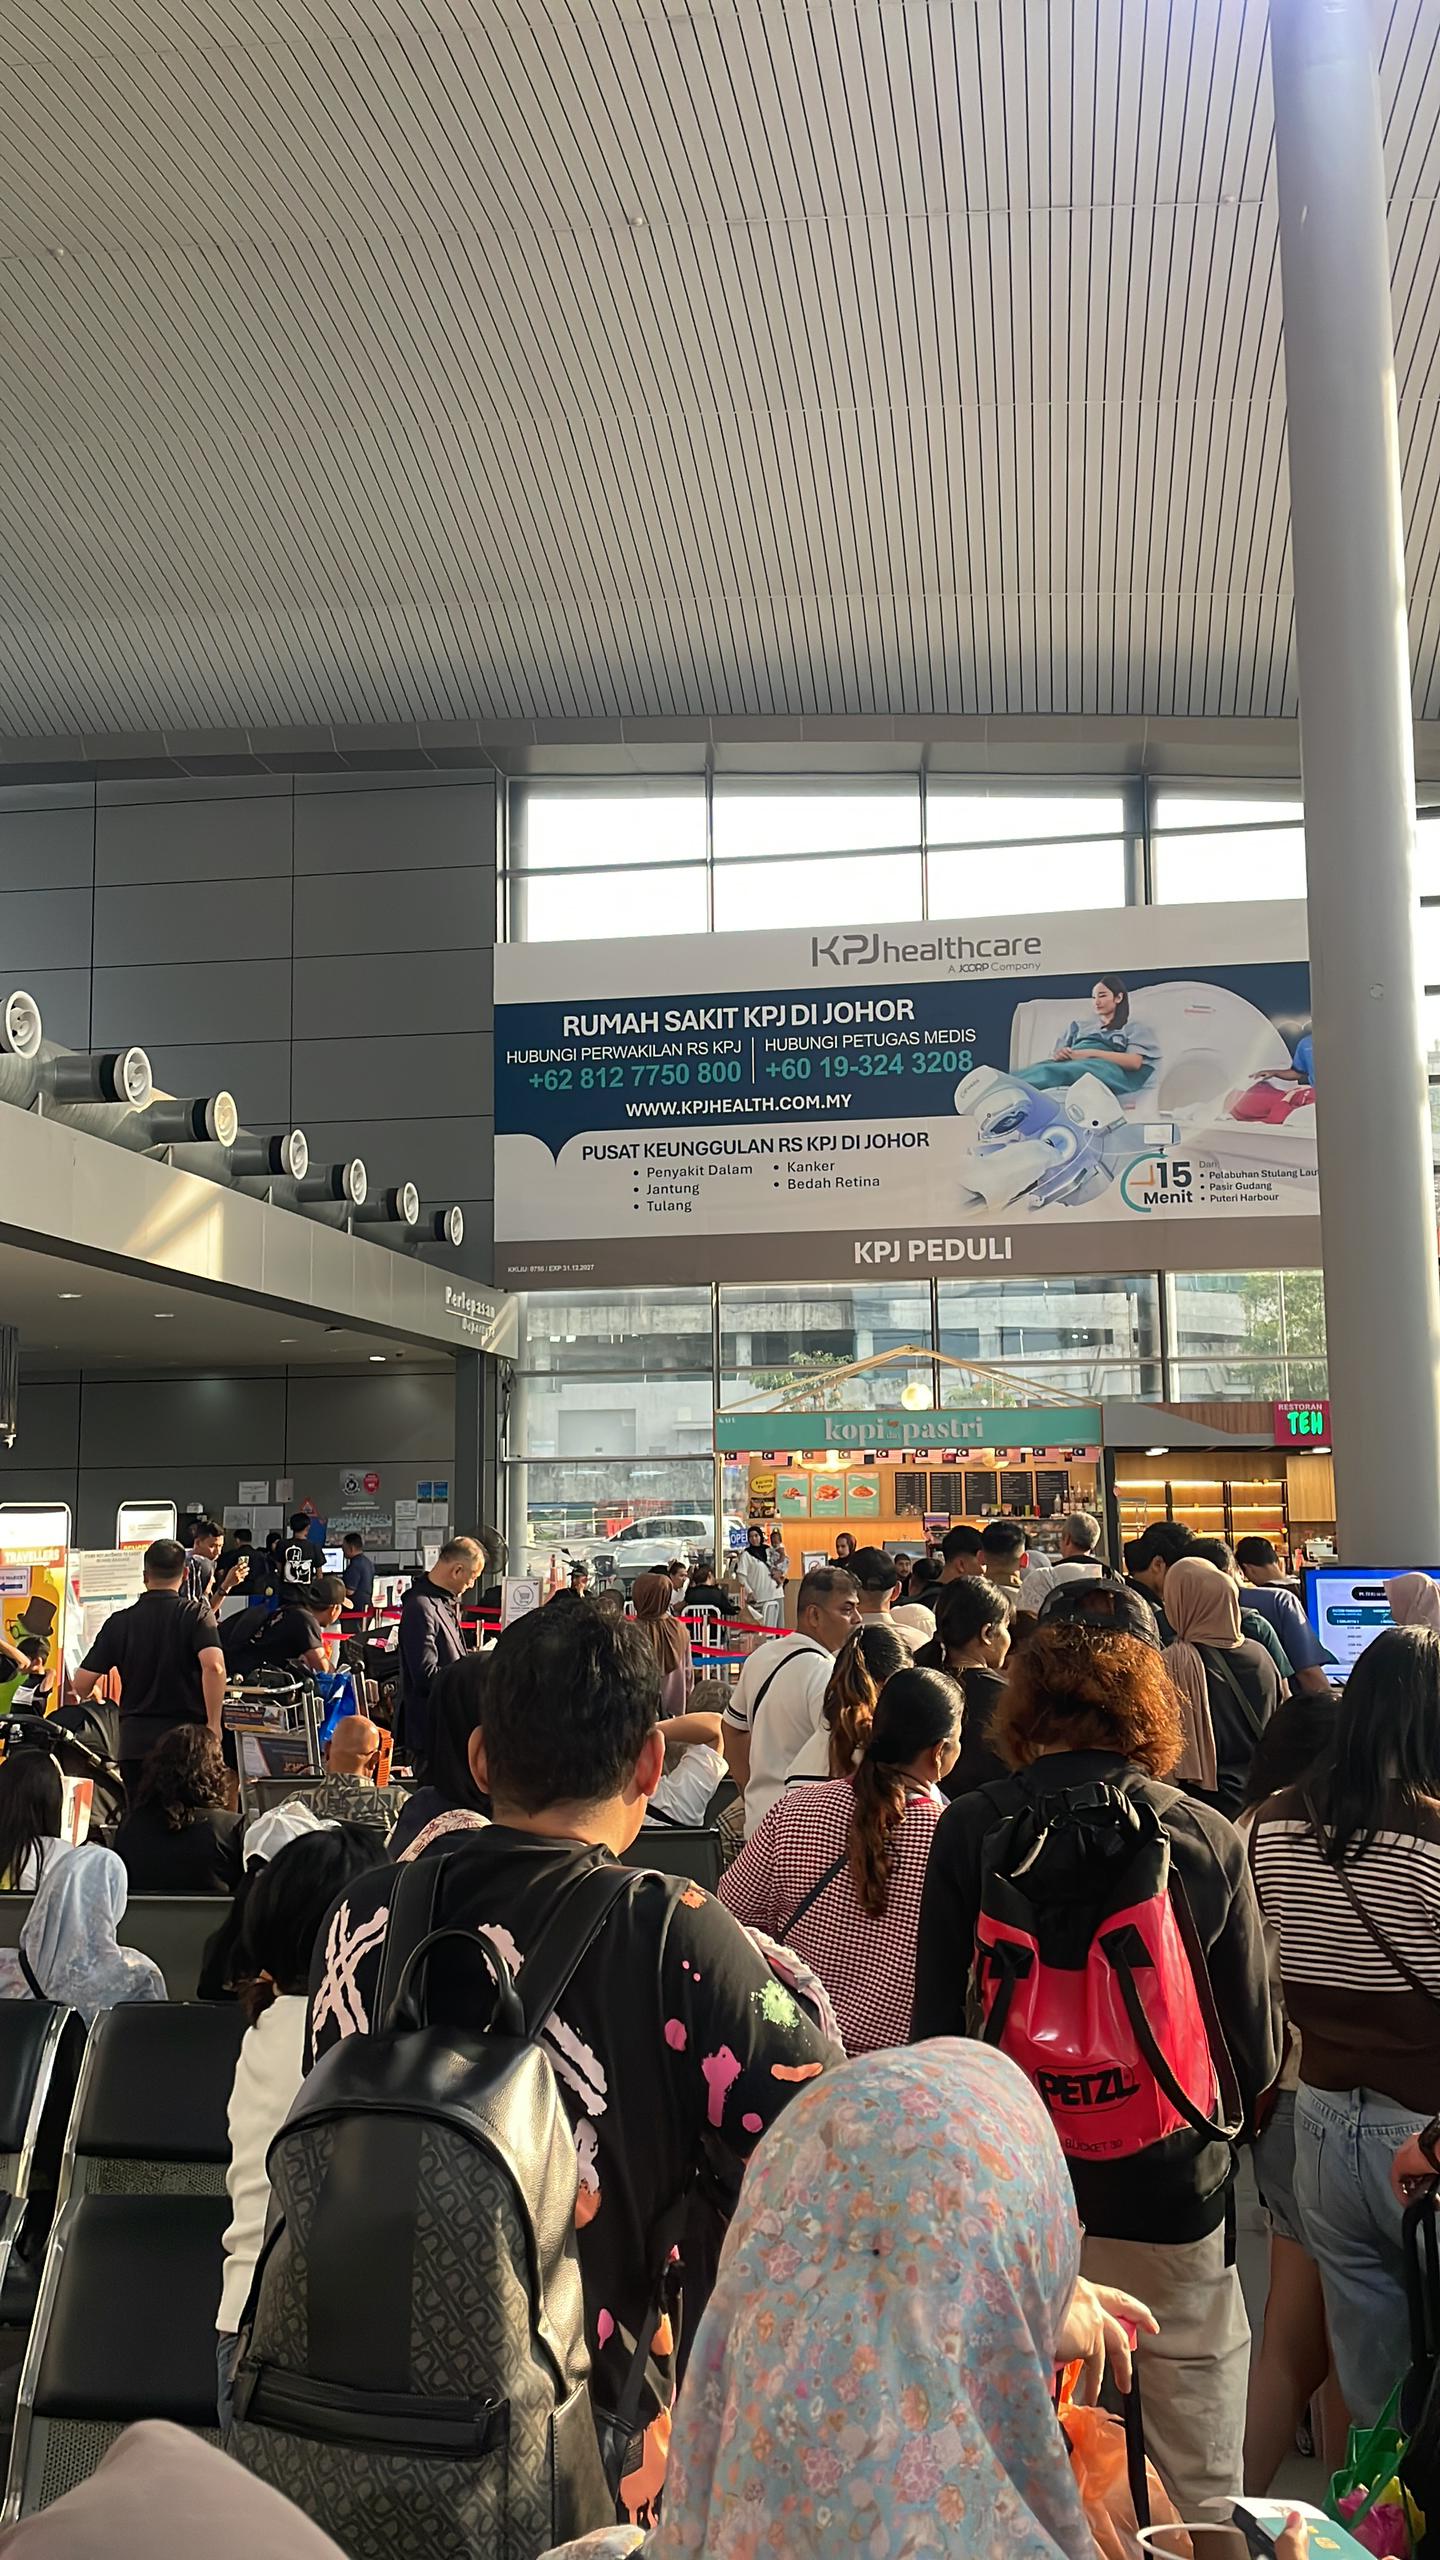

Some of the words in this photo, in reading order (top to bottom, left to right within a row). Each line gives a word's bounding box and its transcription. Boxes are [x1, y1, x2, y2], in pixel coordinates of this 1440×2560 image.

[992, 962, 1041, 971] Company
[563, 1012, 659, 1037] RUMAH
[664, 1007, 739, 1032] SAKIT
[744, 1005, 786, 1028] KPJ
[791, 1003, 818, 1026] DI
[822, 999, 915, 1024] JOHOR
[507, 1047, 577, 1064] HUBUNGI
[581, 1043, 683, 1061] PERWAKILAN
[687, 1042, 708, 1056] RS
[713, 1040, 742, 1054] KPJ
[765, 1036, 838, 1052] HUBUNGI
[842, 1032, 920, 1049] PETUGAS
[924, 1029, 976, 1045] MEDIS
[529, 1069, 573, 1091] +62
[581, 1066, 624, 1088] 812
[632, 1063, 690, 1086] 7750
[698, 1061, 741, 1082] 800
[766, 1058, 811, 1080] +60
[820, 1054, 903, 1077] 19-324
[911, 1050, 973, 1073] 3208
[626, 1094, 852, 1117] WWW.KPJHEALTH.COM.MY
[582, 1144, 639, 1161] PUSAT
[644, 1138, 773, 1159] KEUNGGULAN
[779, 1137, 802, 1153] RS
[807, 1136, 837, 1152] KPJ
[841, 1134, 860, 1149] DI
[864, 1132, 929, 1149] JOHOR
[647, 1166, 704, 1179] Penyakit
[708, 1164, 753, 1177] Dalam
[787, 1161, 835, 1173] Kanker
[1157, 1162, 1192, 1188] 15
[1210, 1171, 1259, 1179] Pelabuhan
[1261, 1170, 1297, 1178] Stulang
[647, 1182, 700, 1197] Jantung
[787, 1177, 832, 1190] Bedah
[836, 1176, 880, 1188] Retina
[1210, 1183, 1233, 1191] Pasir
[1236, 1182, 1272, 1190] Gudang
[647, 1199, 692, 1214] Tulang
[1144, 1191, 1192, 1204] Menit
[854, 1241, 900, 1264] KPJ
[908, 1237, 1012, 1261] PEDULI
[445, 1286, 495, 1318] Perlepasan
[824, 1417, 884, 1448] kopi
[902, 1417, 984, 1446] pastri
[1287, 1411, 1323, 1435] TEH
[1038, 2068, 1140, 2107] PETZL
